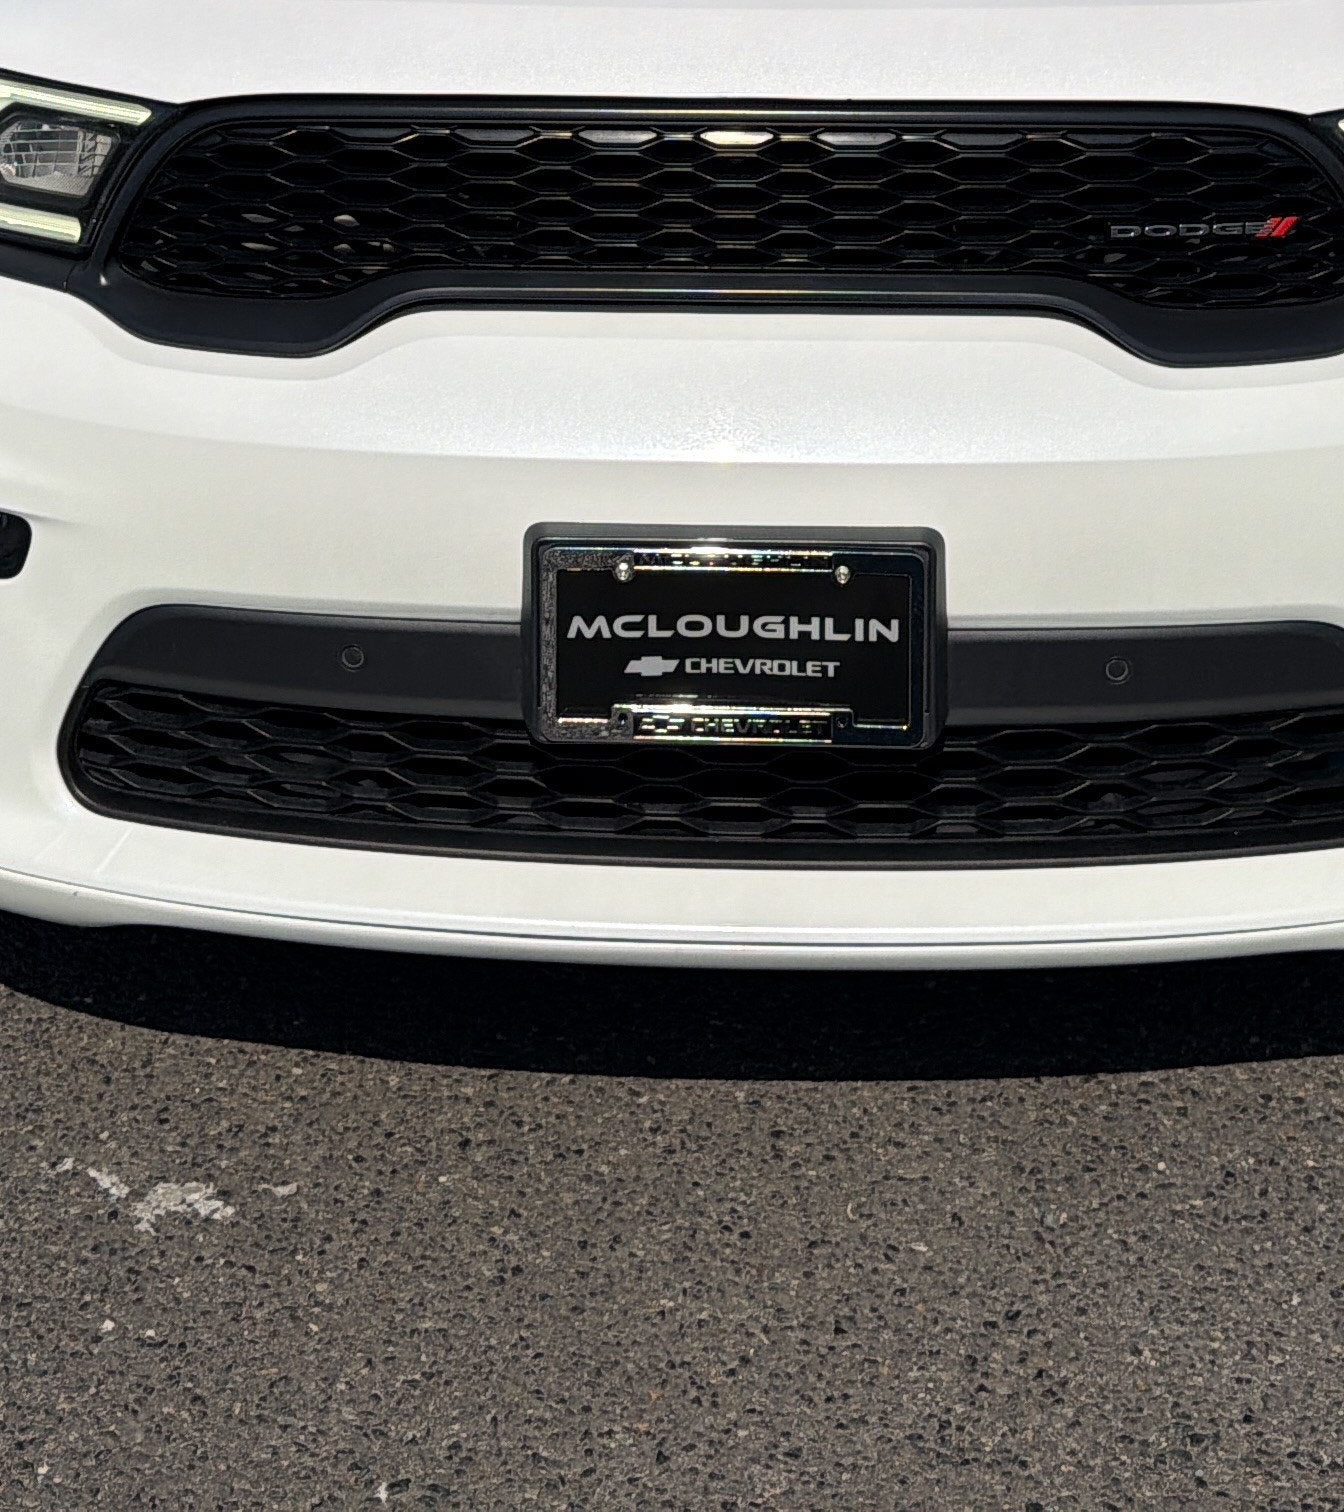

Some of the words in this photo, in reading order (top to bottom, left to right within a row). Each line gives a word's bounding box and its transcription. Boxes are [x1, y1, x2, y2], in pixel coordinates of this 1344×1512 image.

[1110, 221, 1269, 238] DODGE
[567, 615, 899, 642] MCLOUGHLIN
[685, 658, 840, 677] CHEVROLET
